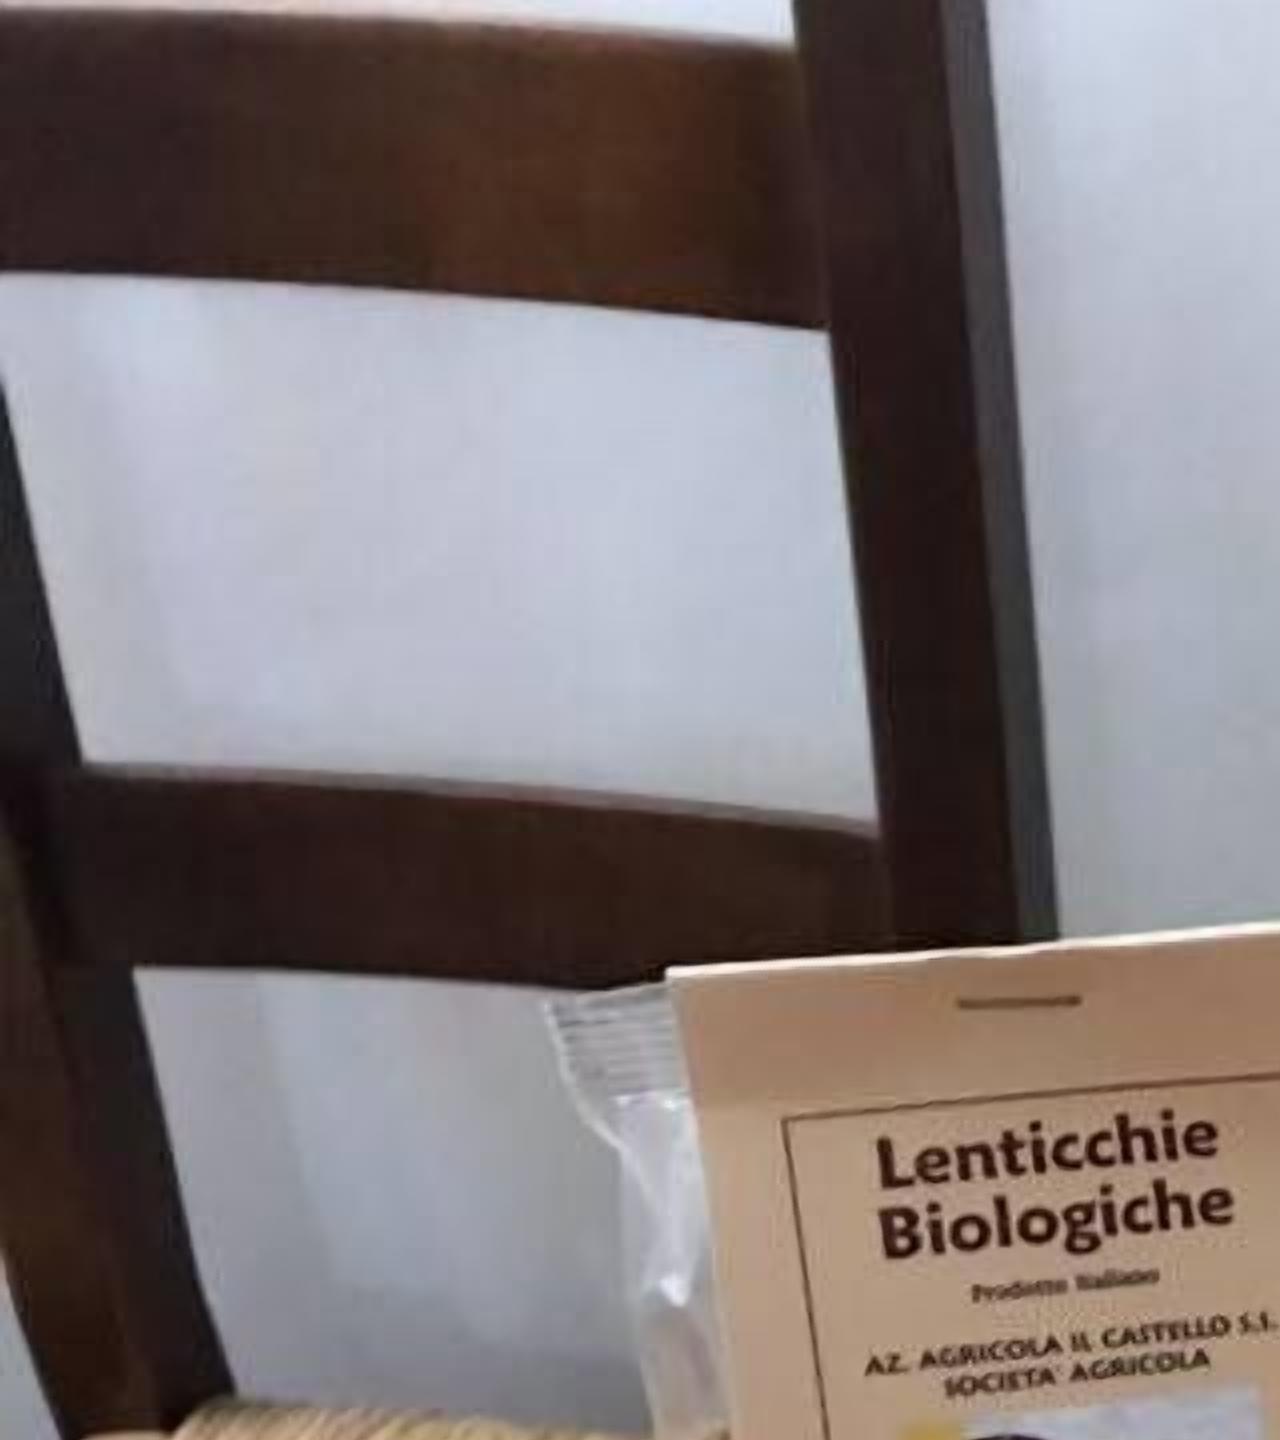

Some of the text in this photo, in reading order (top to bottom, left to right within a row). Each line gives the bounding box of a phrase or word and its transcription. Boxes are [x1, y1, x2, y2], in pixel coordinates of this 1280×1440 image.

[877, 1108, 1218, 1189] Lenticchie
[878, 1178, 1235, 1260] Biologiche
[919, 1333, 1063, 1370] AGRICOLA
[1069, 1330, 1093, 1353] IL
[1100, 1314, 1232, 1349] CASTELLO
[1069, 1346, 1211, 1382] AGRICOLA
